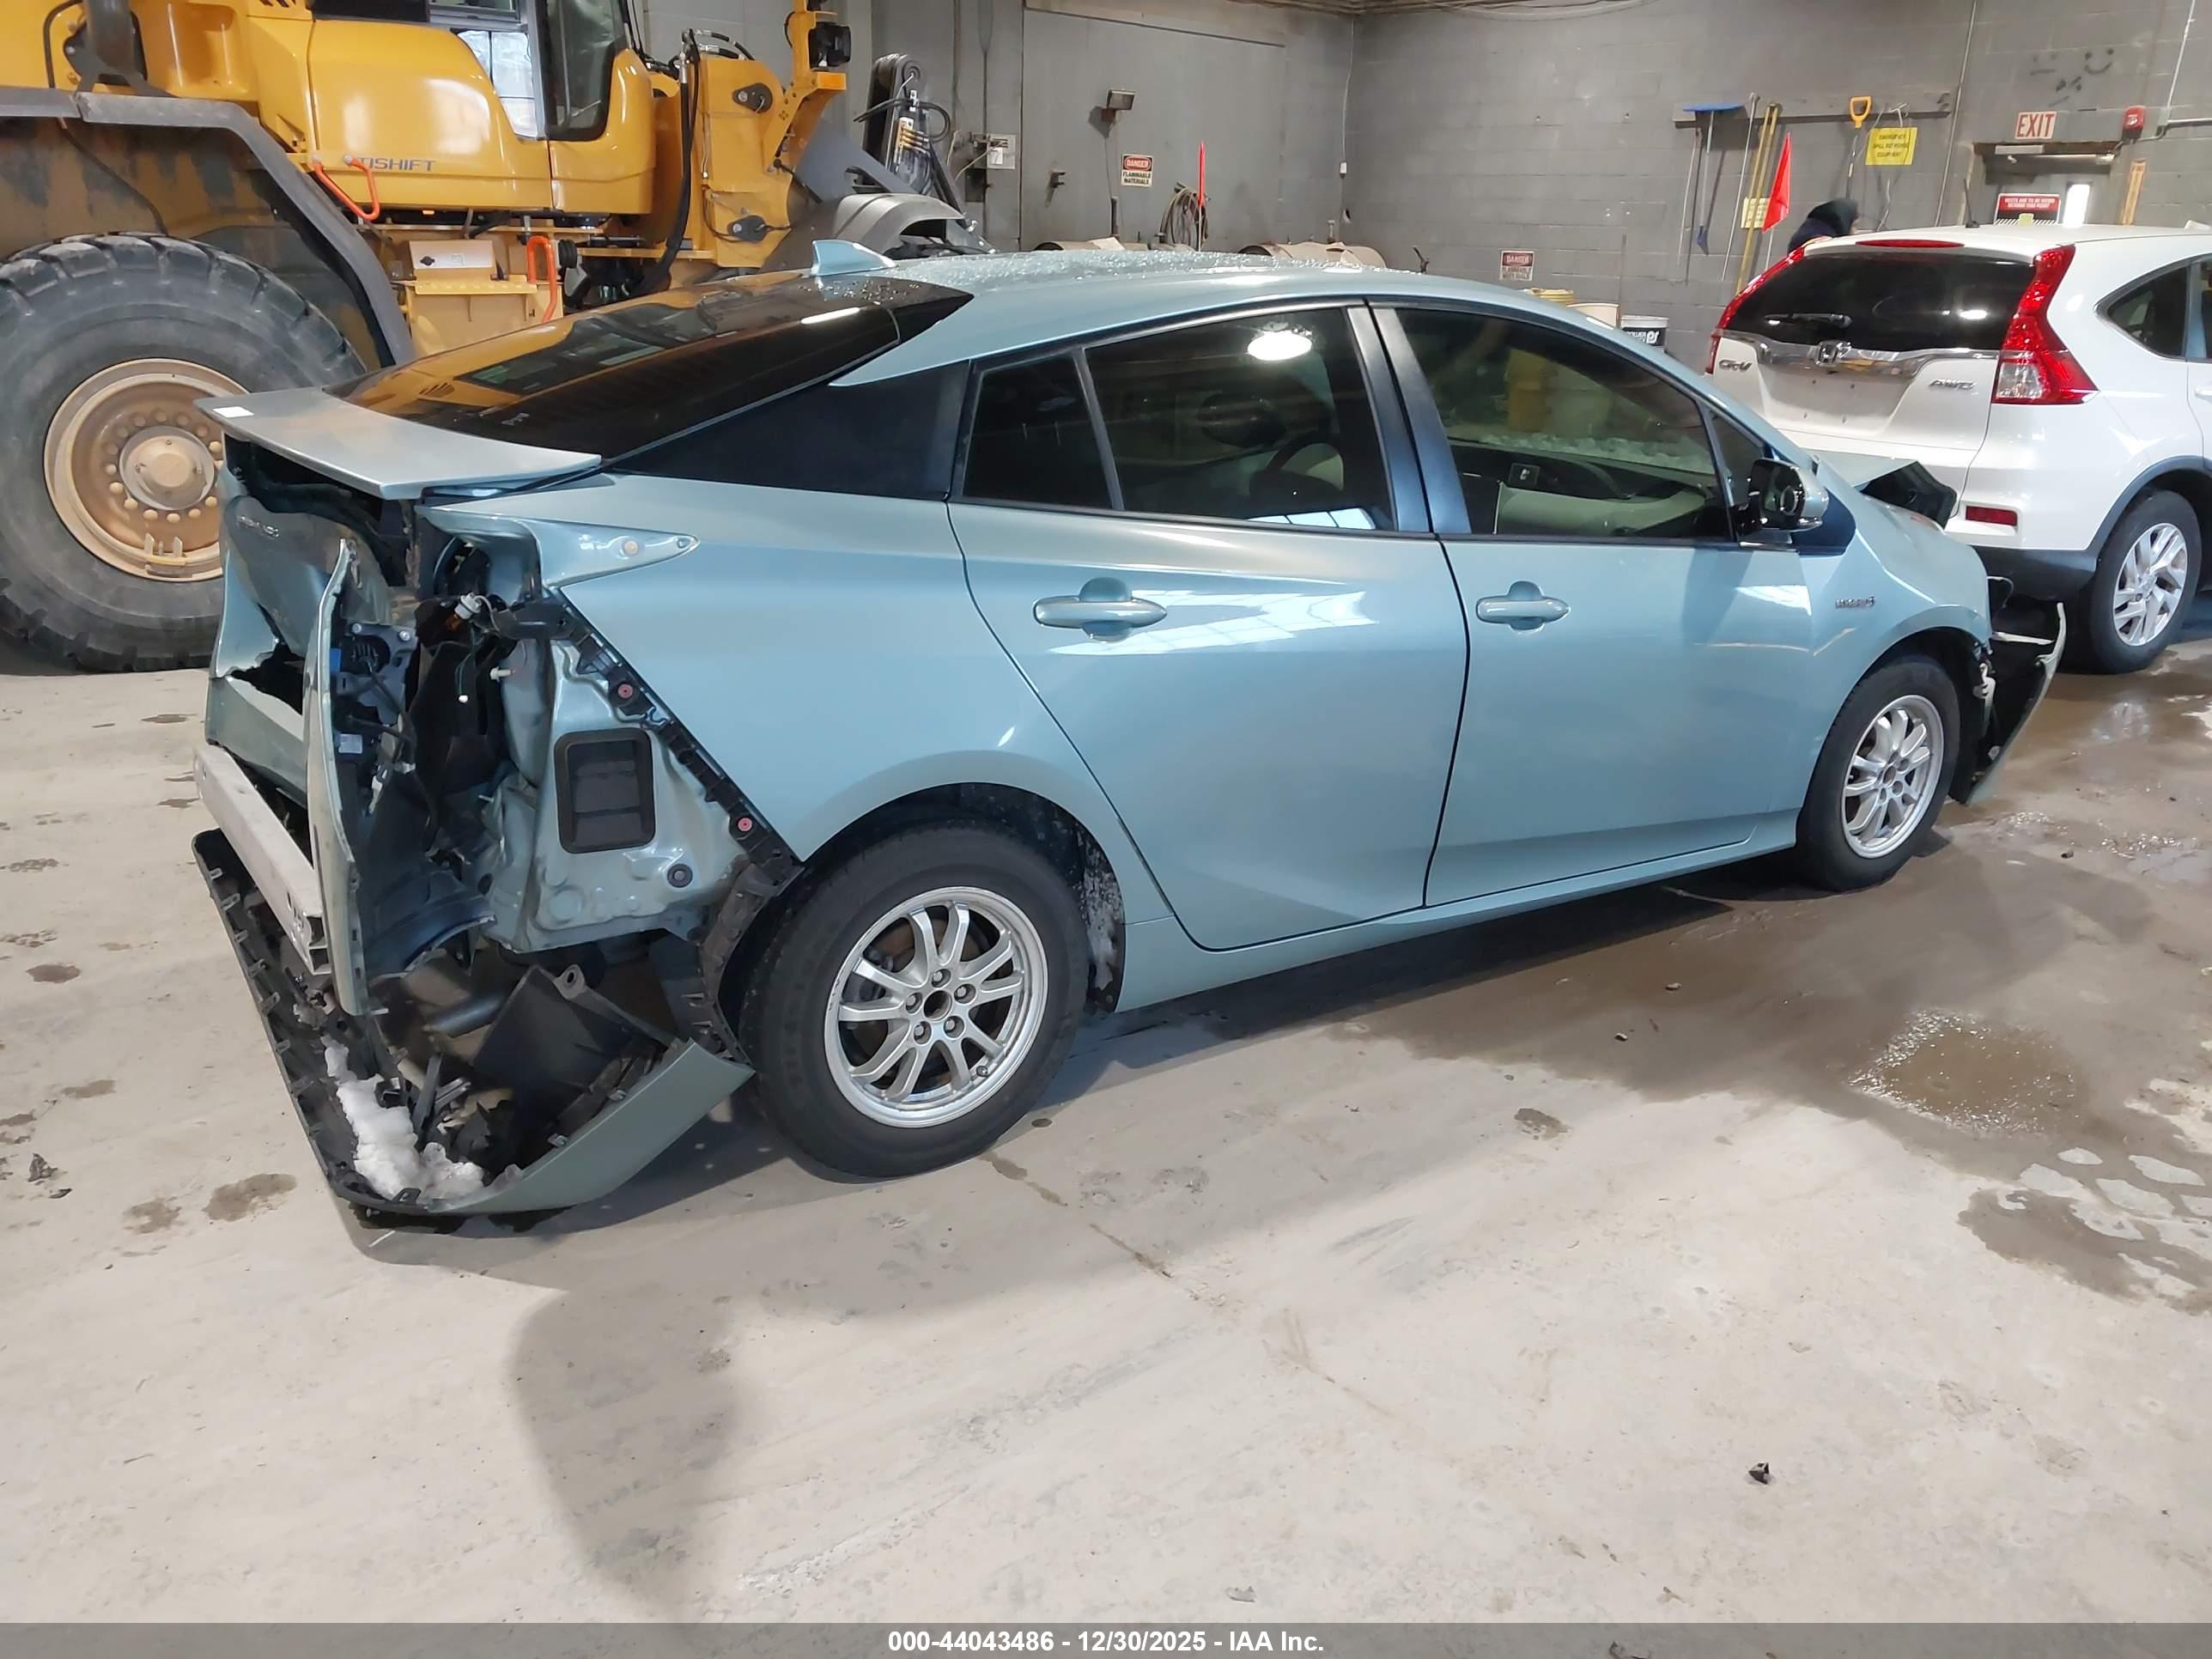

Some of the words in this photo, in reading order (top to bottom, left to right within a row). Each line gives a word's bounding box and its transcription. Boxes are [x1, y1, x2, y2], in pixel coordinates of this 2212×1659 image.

[2017, 113, 2055, 137] EXIT
[1126, 158, 1149, 168] DANGER
[1123, 171, 1151, 179] FLAMMABLE
[1506, 255, 1529, 264] DANGER
